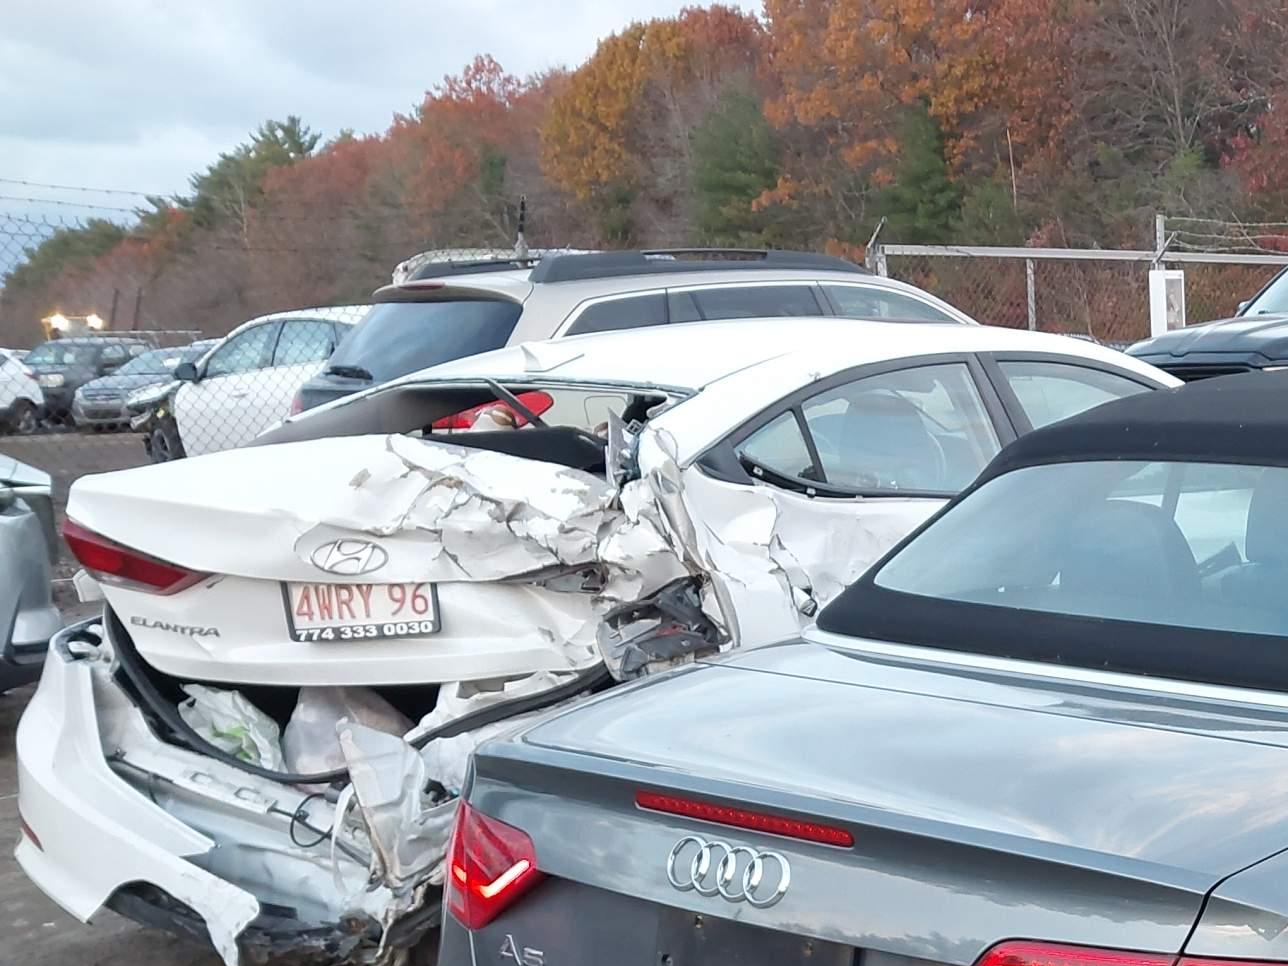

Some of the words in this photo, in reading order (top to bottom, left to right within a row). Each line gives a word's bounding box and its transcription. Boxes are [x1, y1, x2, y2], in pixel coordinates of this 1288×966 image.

[296, 583, 373, 621] 4WRY
[387, 583, 429, 616] 96
[130, 616, 220, 637] ELANTRA
[296, 629, 335, 641] 774
[340, 625, 378, 639] 333
[383, 621, 433, 635] 0030
